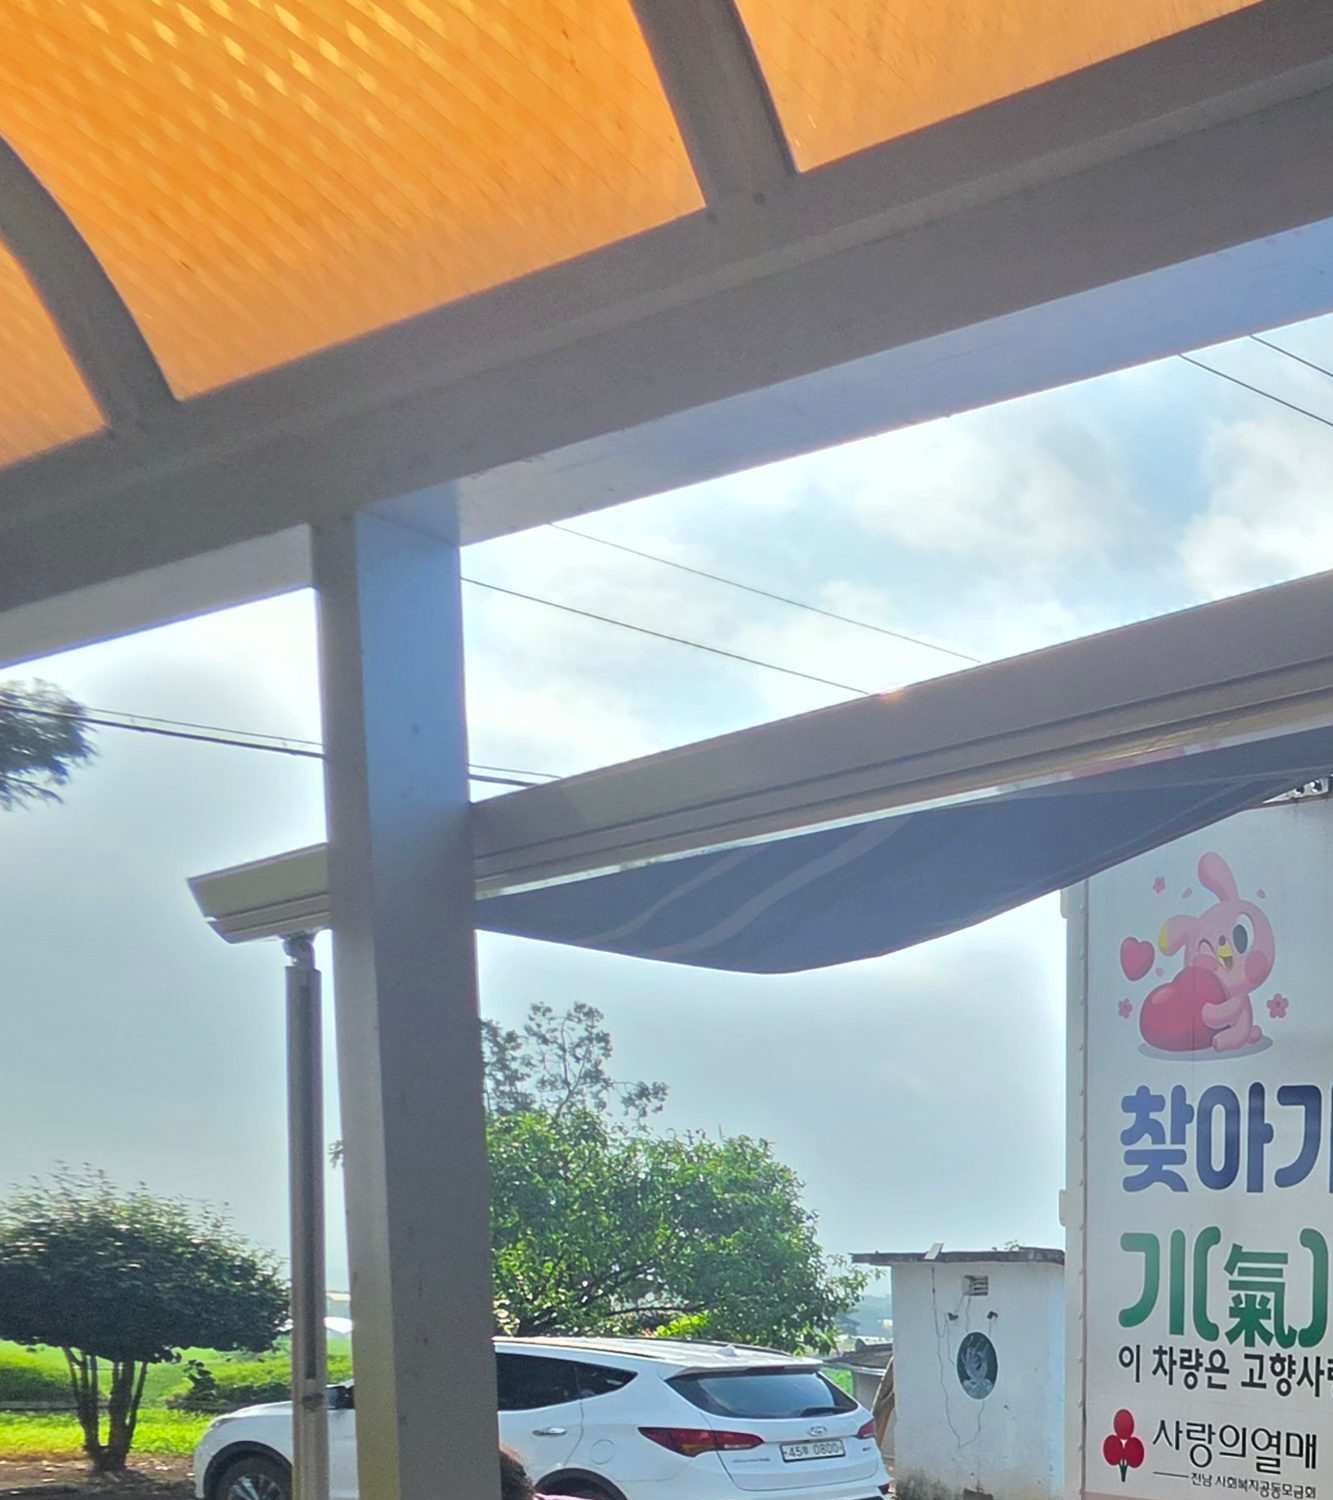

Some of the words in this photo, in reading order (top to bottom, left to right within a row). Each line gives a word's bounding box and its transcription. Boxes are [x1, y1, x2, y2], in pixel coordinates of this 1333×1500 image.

[1118, 1344, 1143, 1383] 이
[1152, 1346, 1230, 1391] 차량은
[1152, 1419, 1318, 1475] 사랑의열매
[1191, 1472, 1212, 1488] 전남
[1215, 1476, 1317, 1500] 사회복지공동모금회
